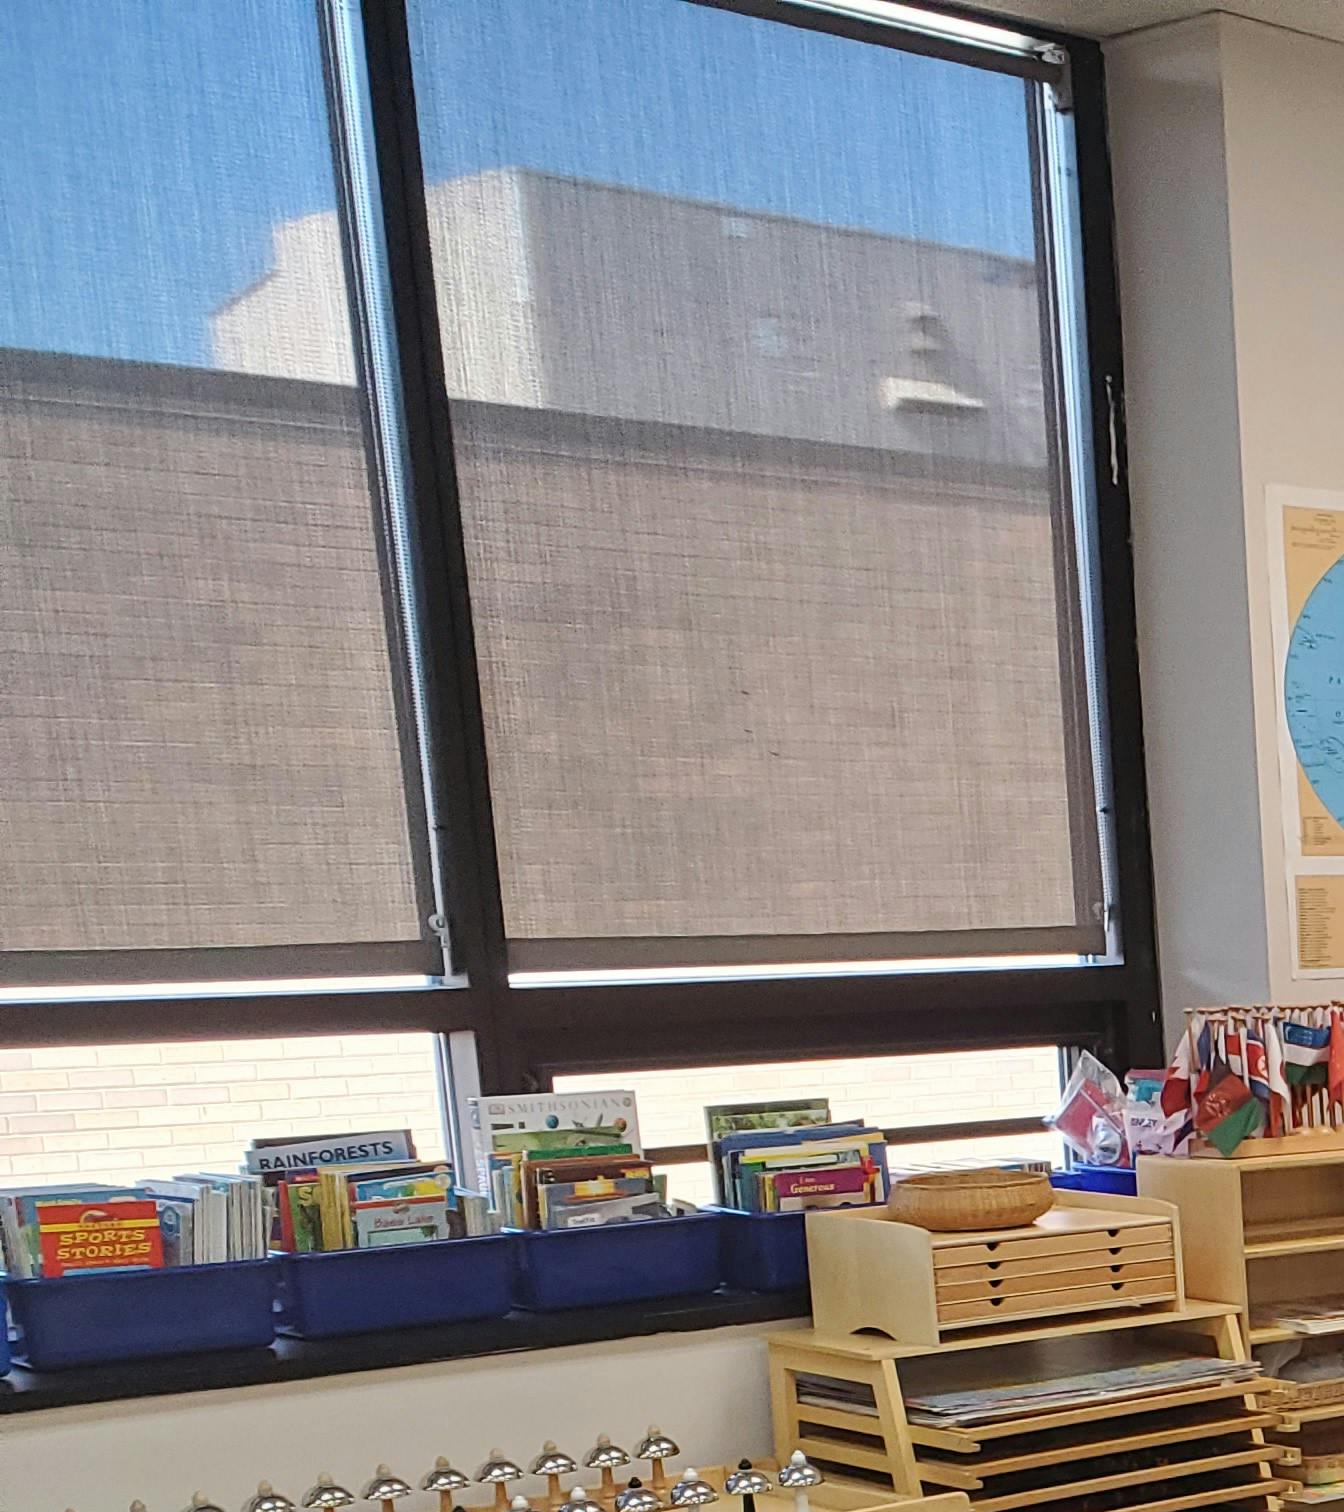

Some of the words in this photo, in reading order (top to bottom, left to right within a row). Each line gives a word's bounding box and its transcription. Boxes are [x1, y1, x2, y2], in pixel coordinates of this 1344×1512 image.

[507, 1098, 622, 1115] SMITHSONIAN
[259, 1141, 394, 1170] RAINFORESTS
[790, 1182, 836, 1194] Generous
[60, 1229, 145, 1246] SPORTS
[57, 1242, 153, 1260] STORIES
